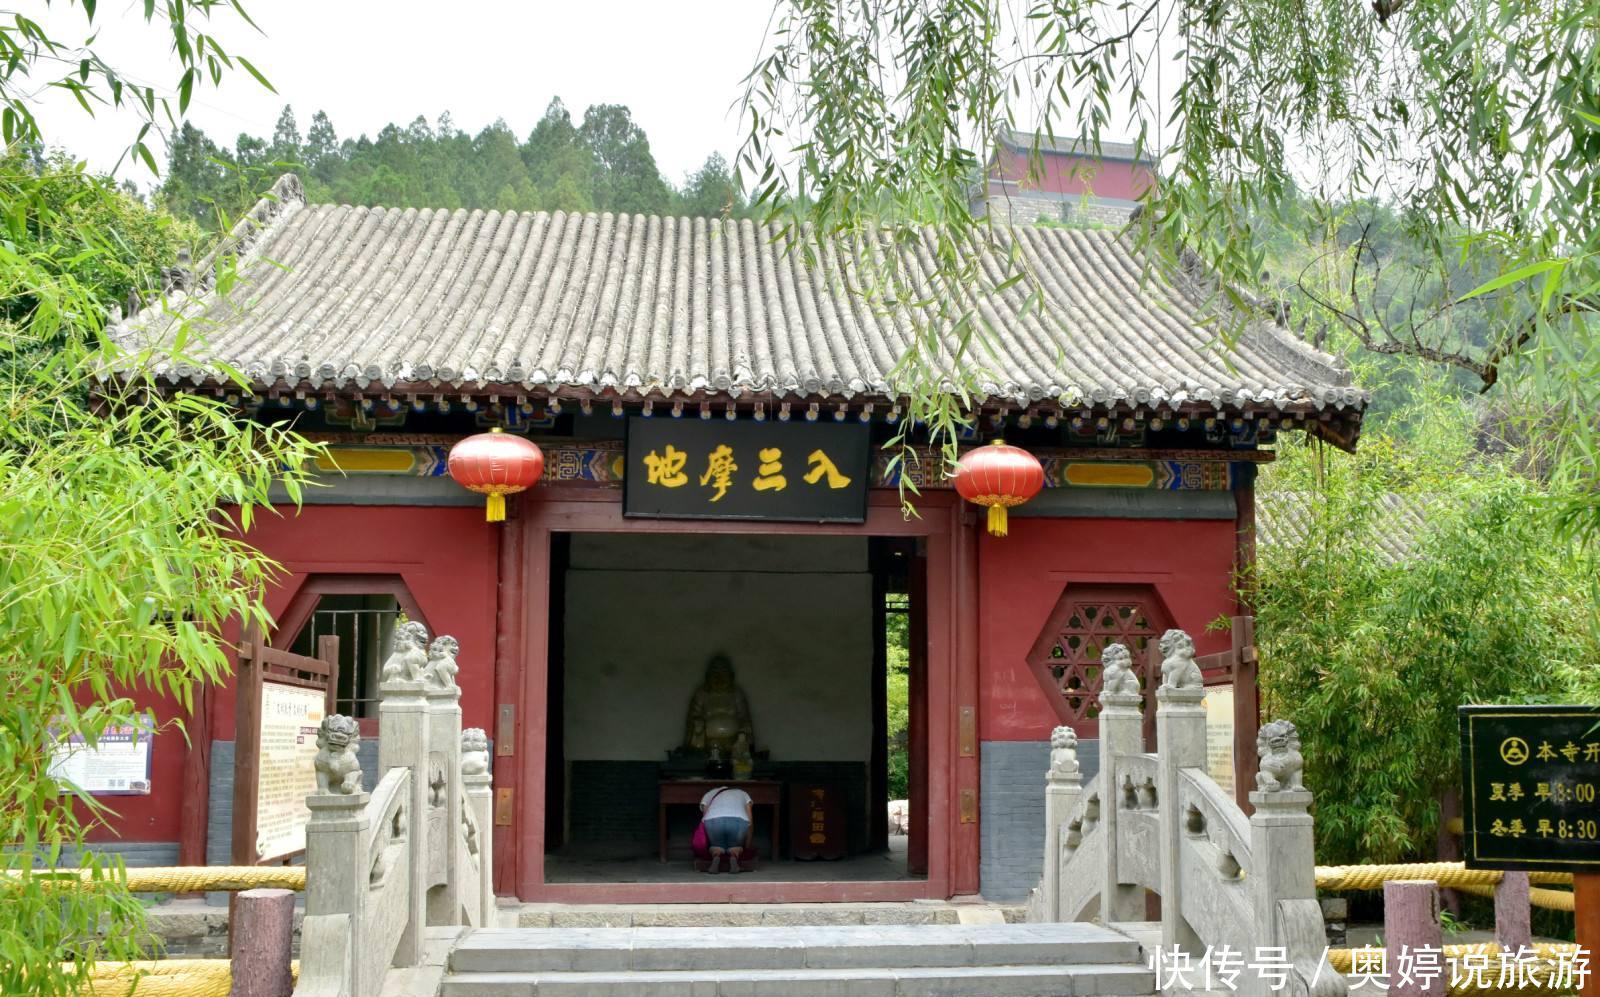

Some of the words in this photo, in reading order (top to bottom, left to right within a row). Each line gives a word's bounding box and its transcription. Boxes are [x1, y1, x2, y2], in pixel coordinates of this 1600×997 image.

[1536, 740, 1600, 763] 本寺开
[1489, 782, 1525, 801] 夏季
[1490, 818, 1526, 838] 冬季
